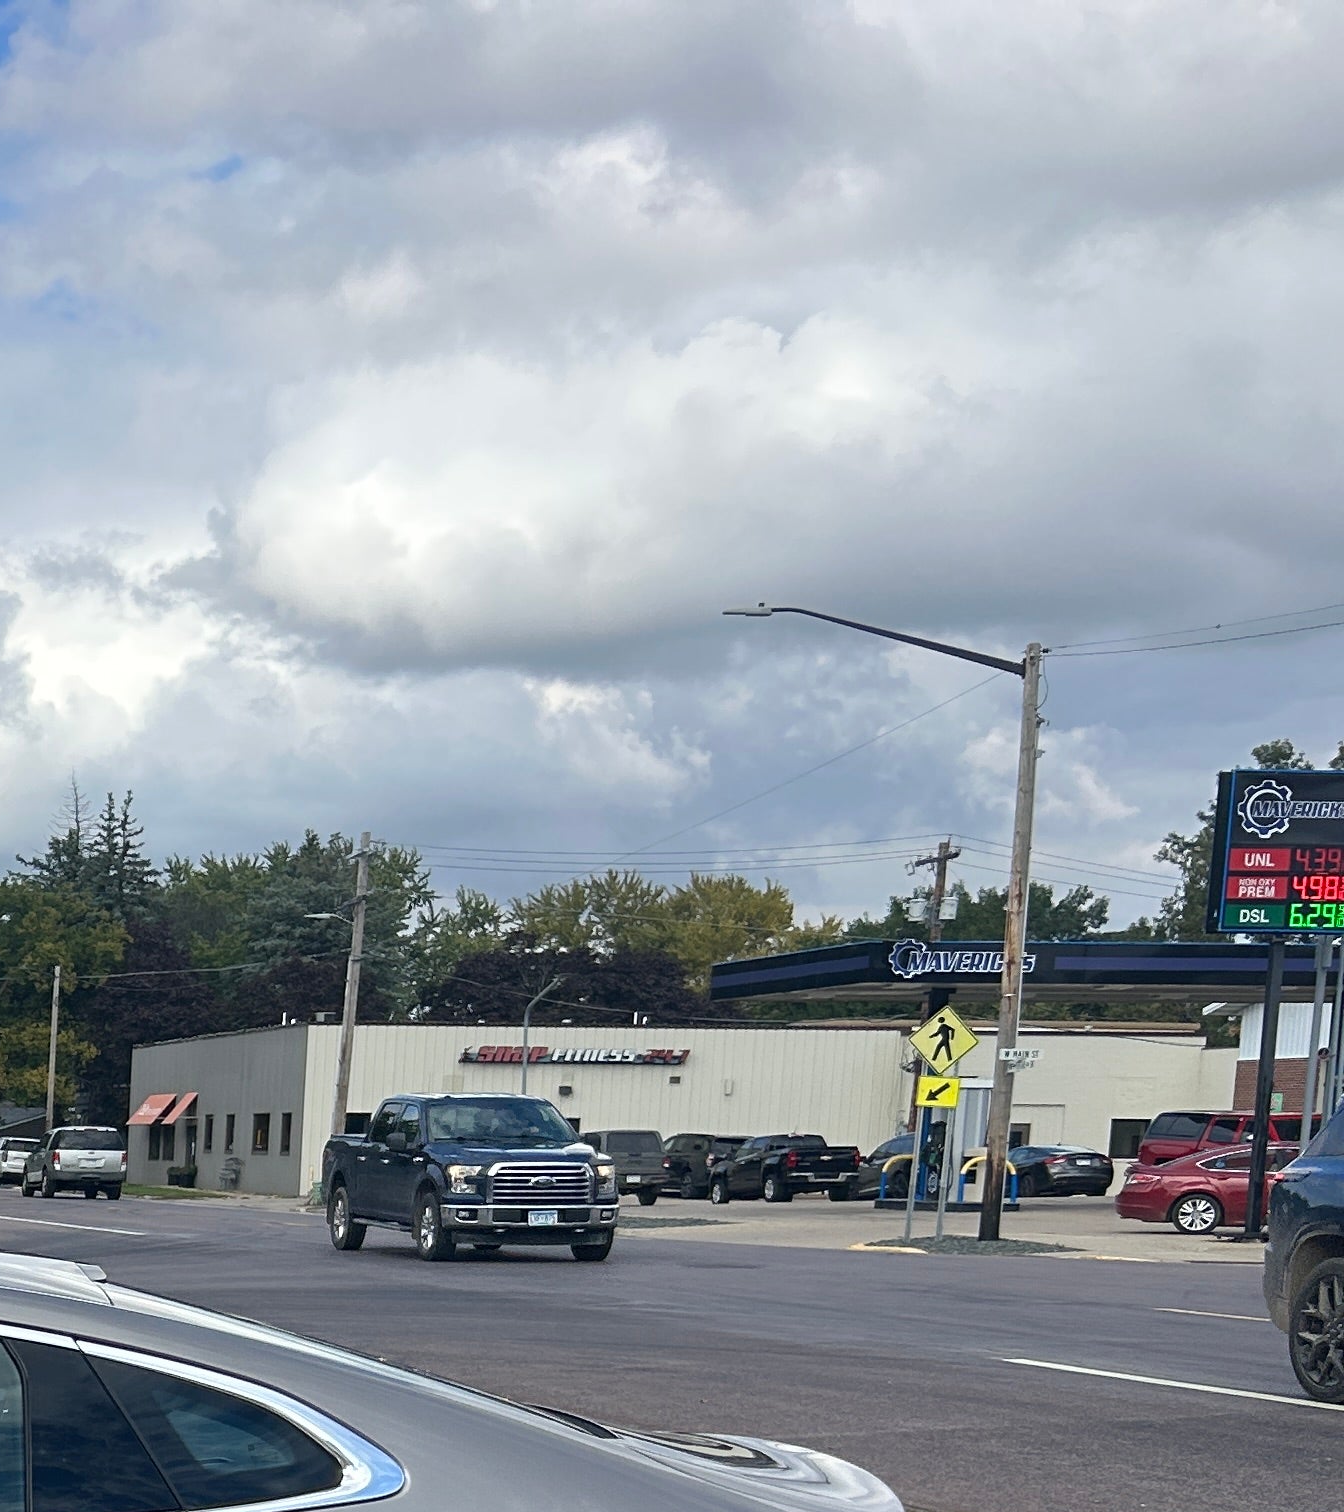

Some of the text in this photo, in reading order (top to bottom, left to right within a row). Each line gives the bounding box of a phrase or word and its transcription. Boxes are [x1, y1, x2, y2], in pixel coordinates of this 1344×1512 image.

[1244, 853, 1275, 867] UNL
[1258, 878, 1276, 886] OXY
[1238, 886, 1276, 898] PREM
[1239, 909, 1269, 923] DSL
